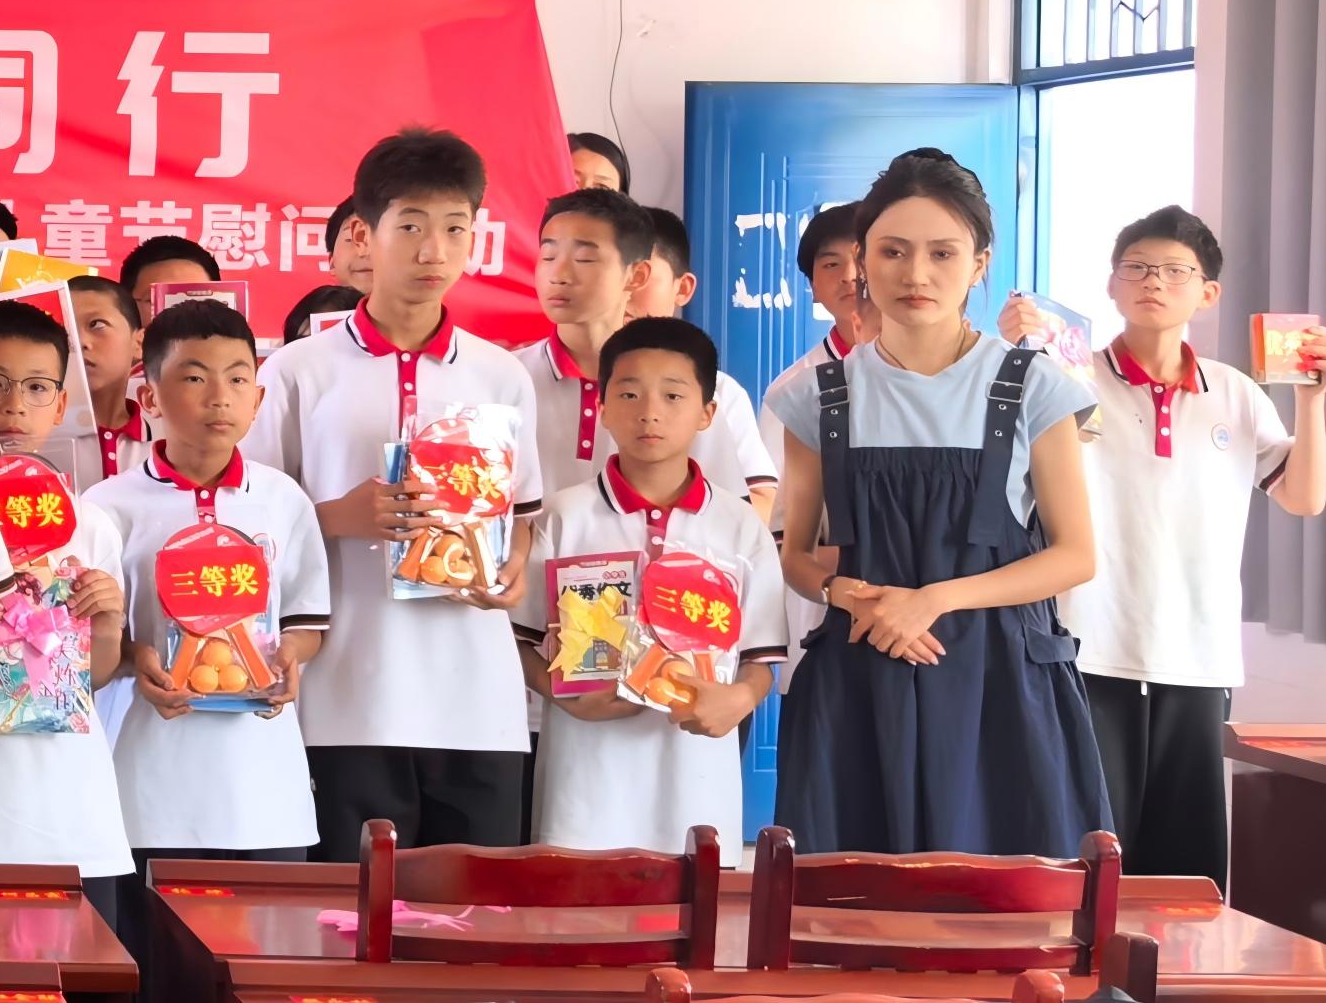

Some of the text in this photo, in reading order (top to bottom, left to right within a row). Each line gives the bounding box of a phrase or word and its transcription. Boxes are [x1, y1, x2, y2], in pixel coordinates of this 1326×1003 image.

[171, 563, 259, 597] 三等奖
[653, 586, 733, 634] 三等奖
